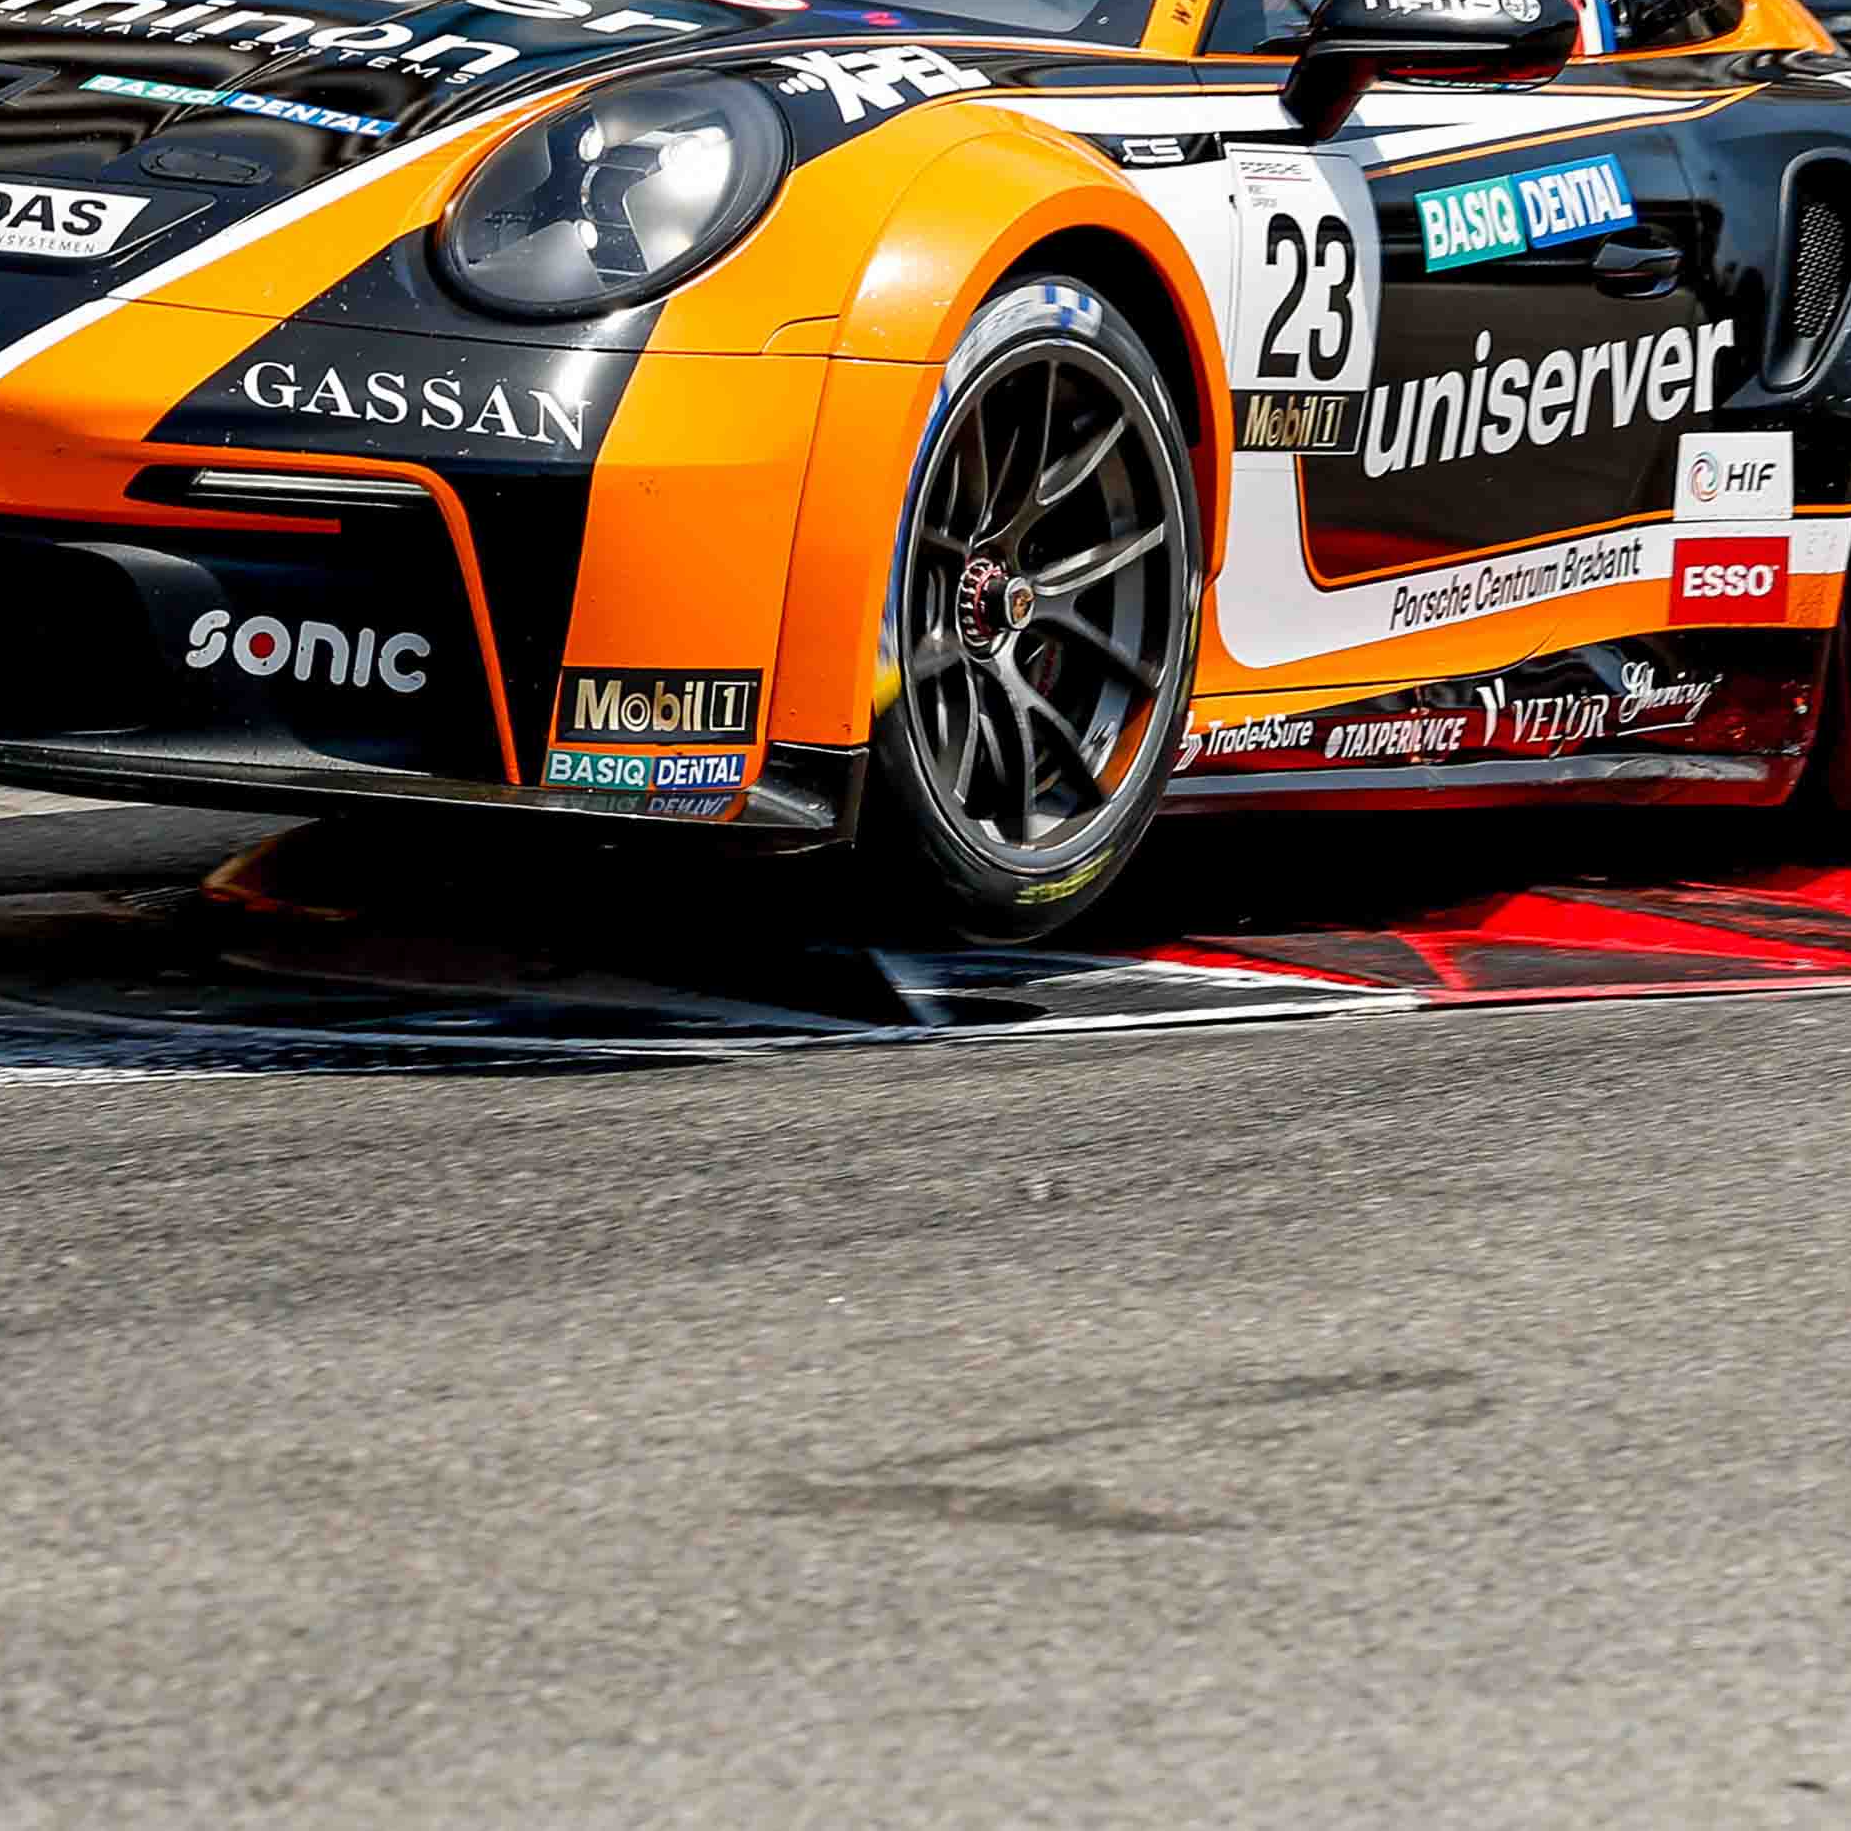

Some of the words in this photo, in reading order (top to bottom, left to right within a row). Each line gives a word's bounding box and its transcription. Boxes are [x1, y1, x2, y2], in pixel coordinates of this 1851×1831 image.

[230, 40, 484, 86] SYSTEMS
[771, 45, 992, 123] XPEL
[91, 77, 220, 104] BASIQ
[232, 95, 393, 136] DENTAL
[1421, 187, 1520, 262] BASIQ
[1526, 164, 1635, 232] DENTAL
[1257, 213, 1355, 381] 23
[242, 360, 593, 451] GASSAN
[1242, 395, 1314, 451] Mobil
[1363, 318, 1736, 479] uniserver
[1726, 461, 1777, 492] HIF
[1389, 573, 1471, 631] Porsche
[1475, 561, 1559, 612] Centrum
[1560, 537, 1643, 591] Brabant
[1683, 564, 1775, 599] ESSO
[573, 677, 706, 733] Mobil
[549, 753, 647, 787] BASIQ
[656, 754, 742, 786] DENTAL
